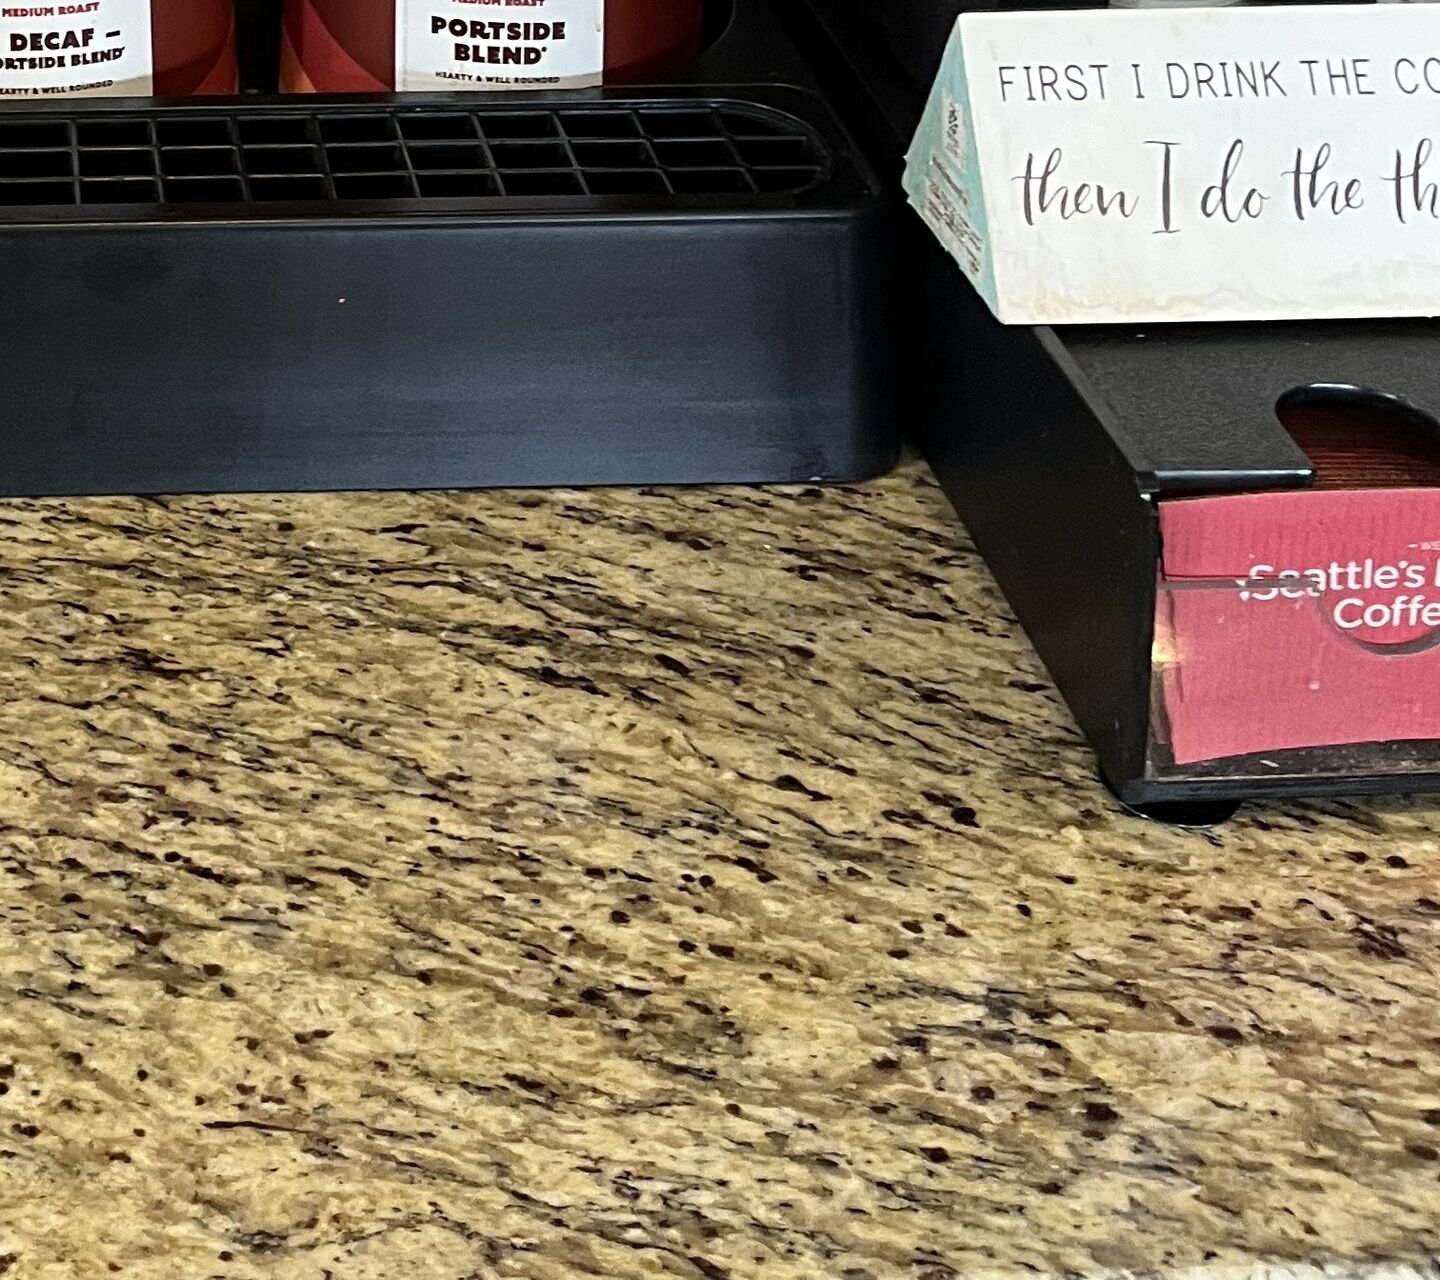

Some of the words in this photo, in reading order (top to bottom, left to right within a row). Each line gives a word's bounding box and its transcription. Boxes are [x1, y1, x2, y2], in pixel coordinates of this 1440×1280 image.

[2, 7, 55, 18] MEDIUM
[57, 1, 100, 15] ROAST
[10, 28, 95, 52] DECAF
[431, 15, 566, 41] PORTSIDE
[998, 64, 1109, 102] FIRST
[1133, 63, 1146, 100] I
[1166, 60, 1287, 100] DRINK
[1299, 58, 1377, 96] THE
[1011, 147, 1141, 227] then
[1144, 139, 1183, 235] I
[1199, 138, 1270, 224] do
[1280, 142, 1365, 222] the
[1248, 558, 1426, 601] Seattle's
[1333, 595, 1440, 629] Coffe
